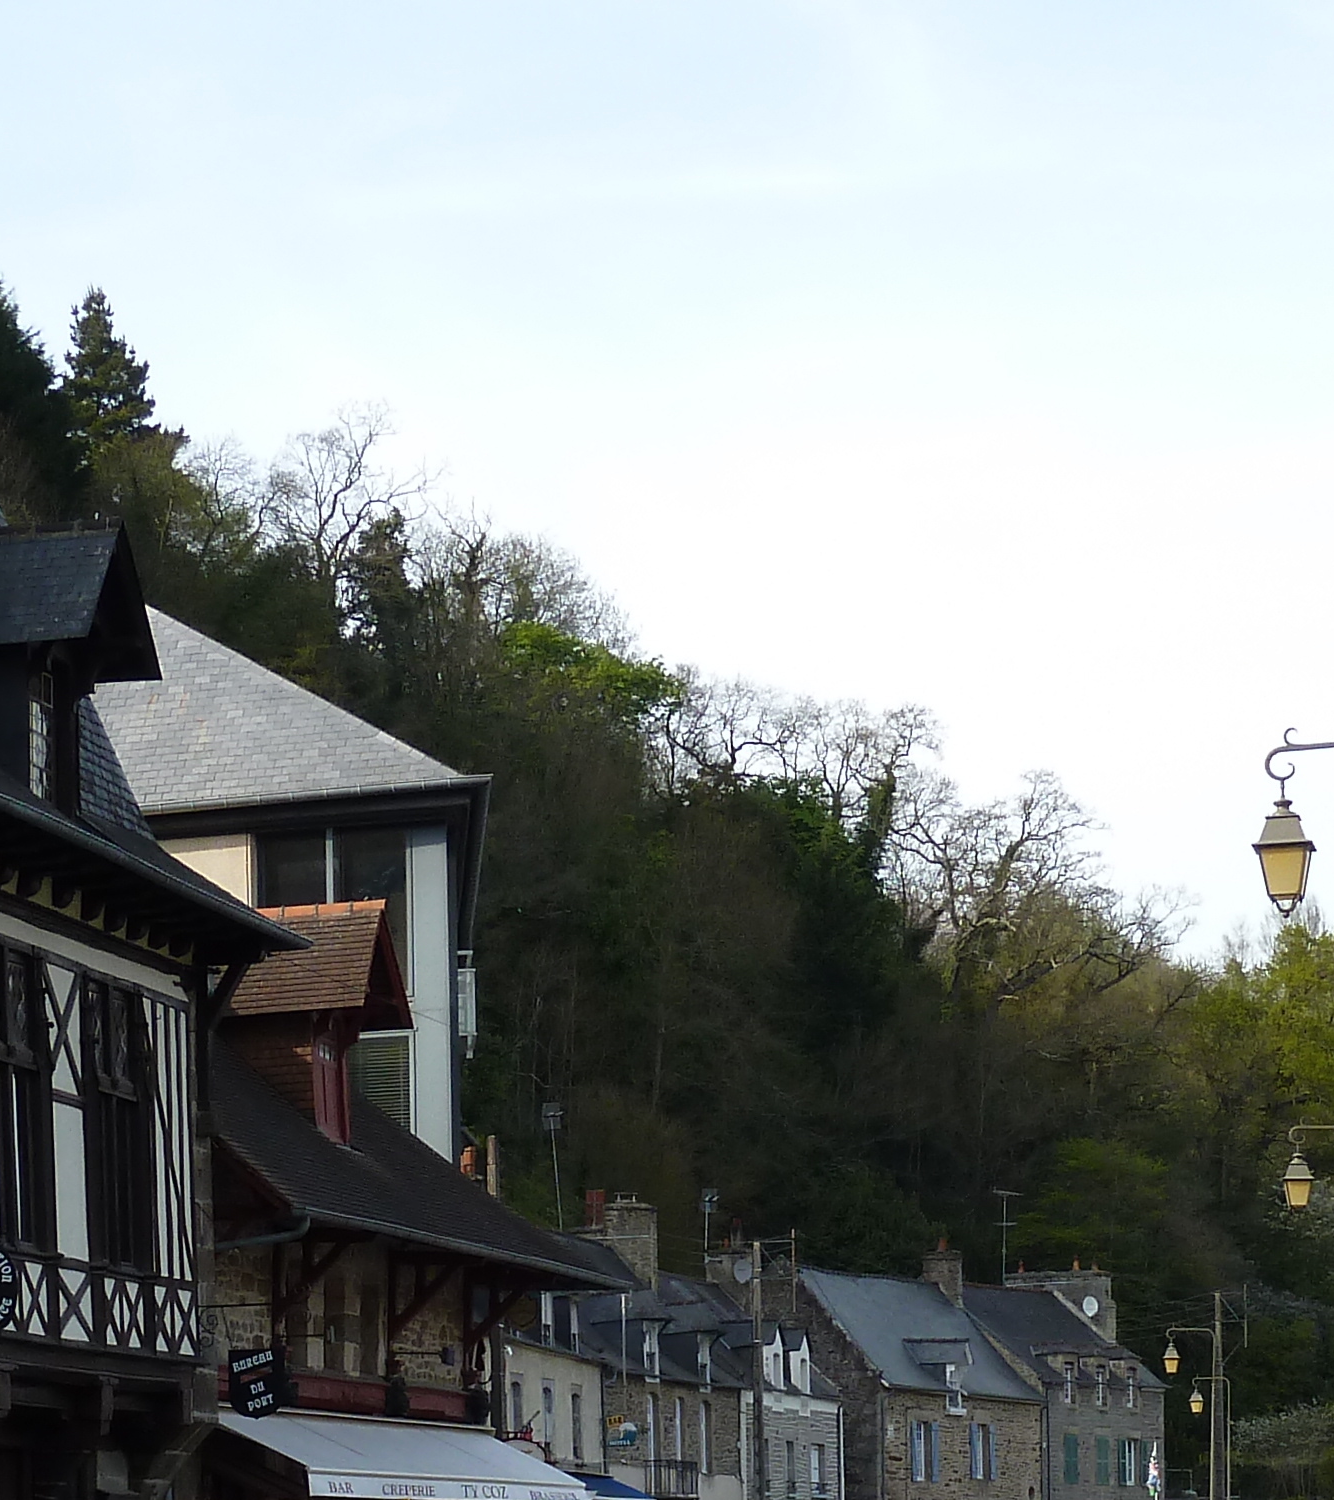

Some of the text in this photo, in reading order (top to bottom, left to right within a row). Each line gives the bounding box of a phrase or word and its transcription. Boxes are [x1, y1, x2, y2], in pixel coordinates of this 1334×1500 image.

[232, 1350, 274, 1373] BUREAU
[249, 1381, 266, 1395] DU
[247, 1393, 274, 1412] PORT
[328, 1481, 354, 1495] BAR
[461, 1484, 478, 1499] TY
[481, 1485, 509, 1499] COZ
